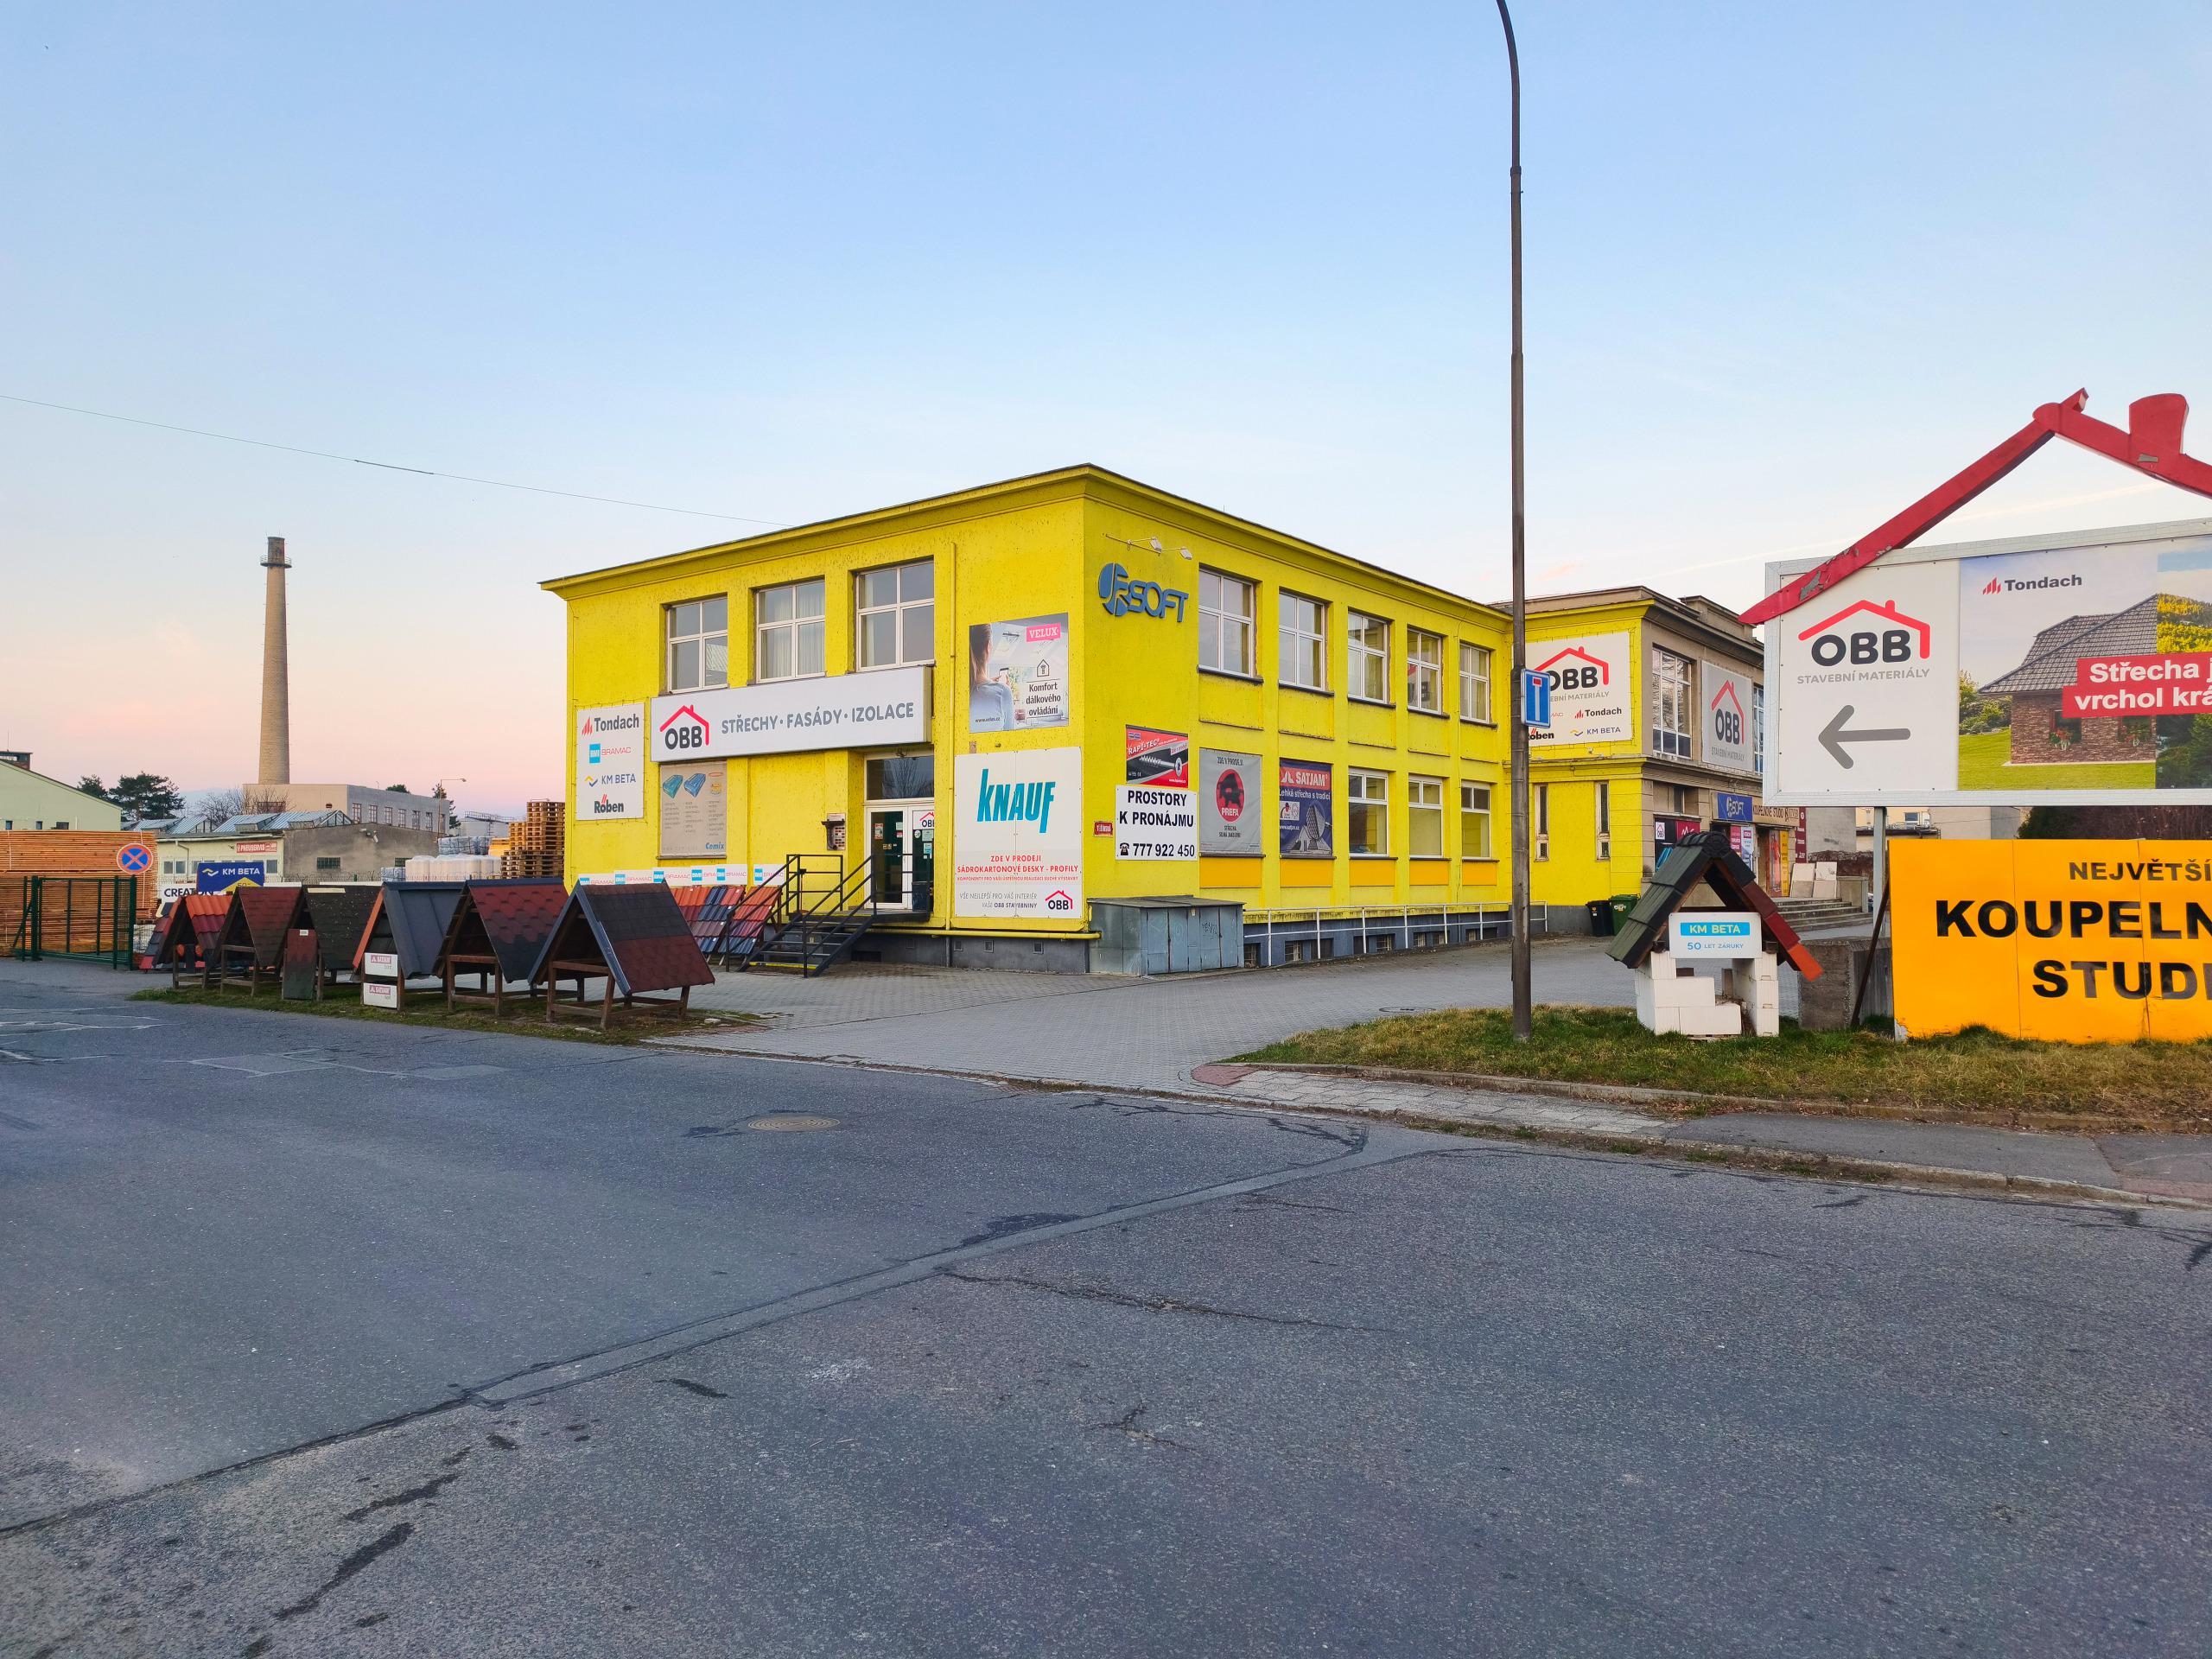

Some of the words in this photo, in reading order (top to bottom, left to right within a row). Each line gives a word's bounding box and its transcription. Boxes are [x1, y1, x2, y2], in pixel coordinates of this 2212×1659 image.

[2005, 574, 2082, 592] Tondach
[1029, 626, 1058, 639] VELUX
[1811, 630, 1911, 666] OBB
[1797, 670, 1855, 684] STAVEBNÍ
[1859, 667, 1930, 681] MATERIÁLY
[2089, 659, 2199, 683] Střecha
[1029, 682, 1058, 692] Komfort
[1026, 694, 1061, 705] dálkového
[1550, 694, 1567, 702] EBNÍ
[1567, 690, 1610, 701] MATERIÁLY
[2075, 687, 2163, 710] vrchol
[721, 714, 778, 734] STŘECHY
[787, 706, 842, 728] FASÁDY
[852, 702, 914, 722] IZOLACE
[1029, 705, 1058, 716] ovládání
[1585, 707, 1622, 717] Tondach
[594, 714, 639, 732] Tondach
[1715, 709, 1739, 745] OBB
[664, 725, 702, 750] OBB
[601, 747, 632, 756] BRAMAC
[601, 775, 613, 785] KM
[614, 773, 636, 784] BETA
[1296, 772, 1325, 786] SATJAM
[594, 793, 625, 814] Röben
[977, 768, 1056, 833] KNAUF
[1128, 790, 1187, 806] PROSTORY
[1119, 810, 1128, 824] K
[1132, 810, 1194, 828] PRONÁJMU
[1221, 807, 1239, 817] PREFA
[705, 841, 725, 849] Cemix
[1133, 842, 1153, 856] 777
[1155, 843, 1174, 857] 922
[1177, 844, 1195, 857] 450
[957, 864, 1021, 873] SÁDROKARTONOVÉ
[2069, 858, 2212, 881] NEJVĚTŠÍ
[1048, 899, 1069, 910] OBB
[1936, 899, 2212, 939] KOUPELN
[1689, 924, 1707, 933] KM
[1712, 924, 1741, 933] BETA
[2032, 959, 2212, 1001] STUDI
